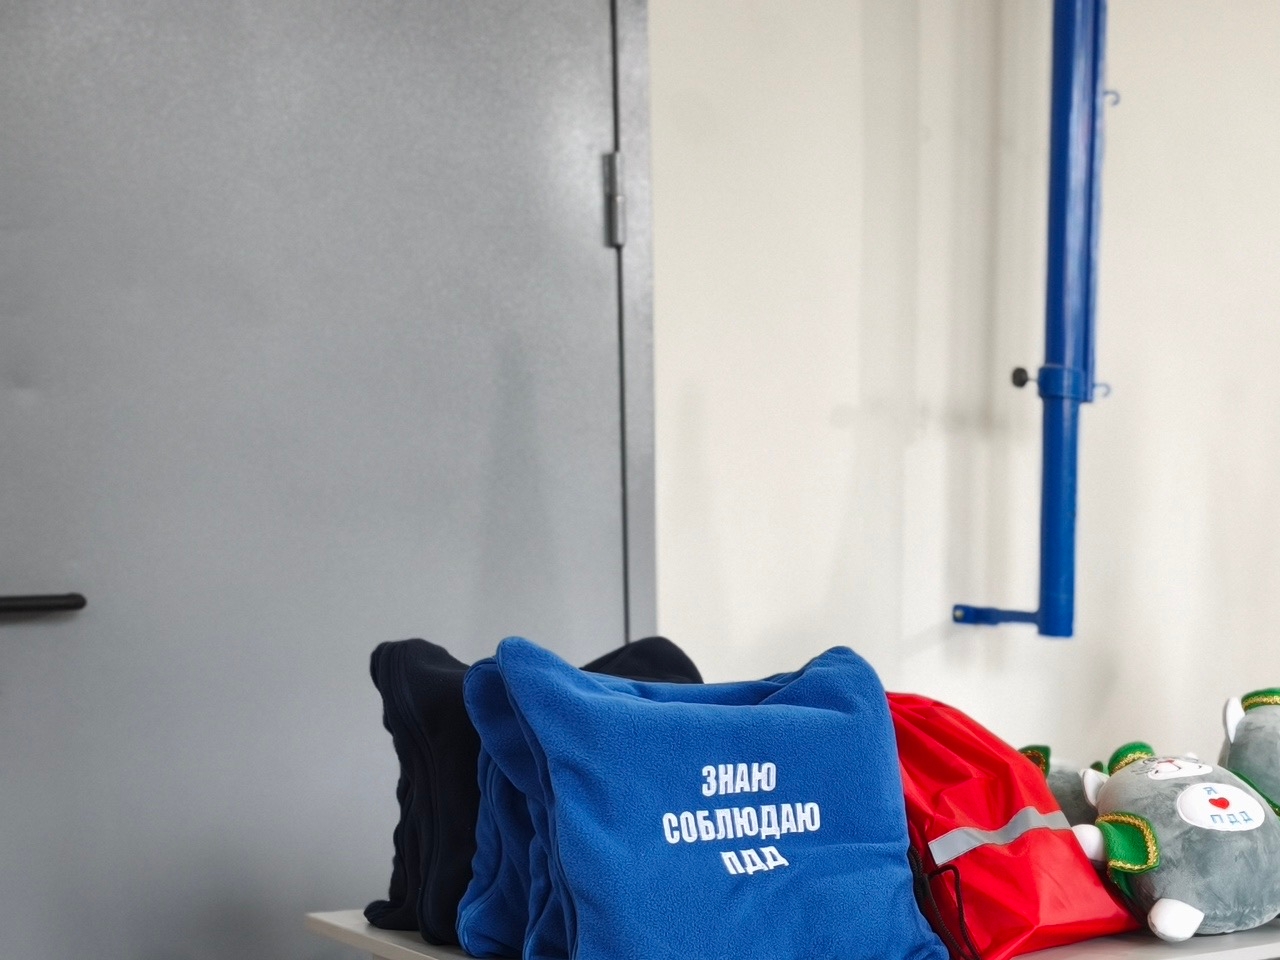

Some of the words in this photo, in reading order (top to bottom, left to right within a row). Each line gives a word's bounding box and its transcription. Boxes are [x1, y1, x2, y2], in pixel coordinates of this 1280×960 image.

[702, 762, 777, 796] ЗНАЮ
[1203, 786, 1217, 795] Я
[662, 802, 821, 844] СОБЛЮДАЮ
[720, 846, 789, 874] ПДД
